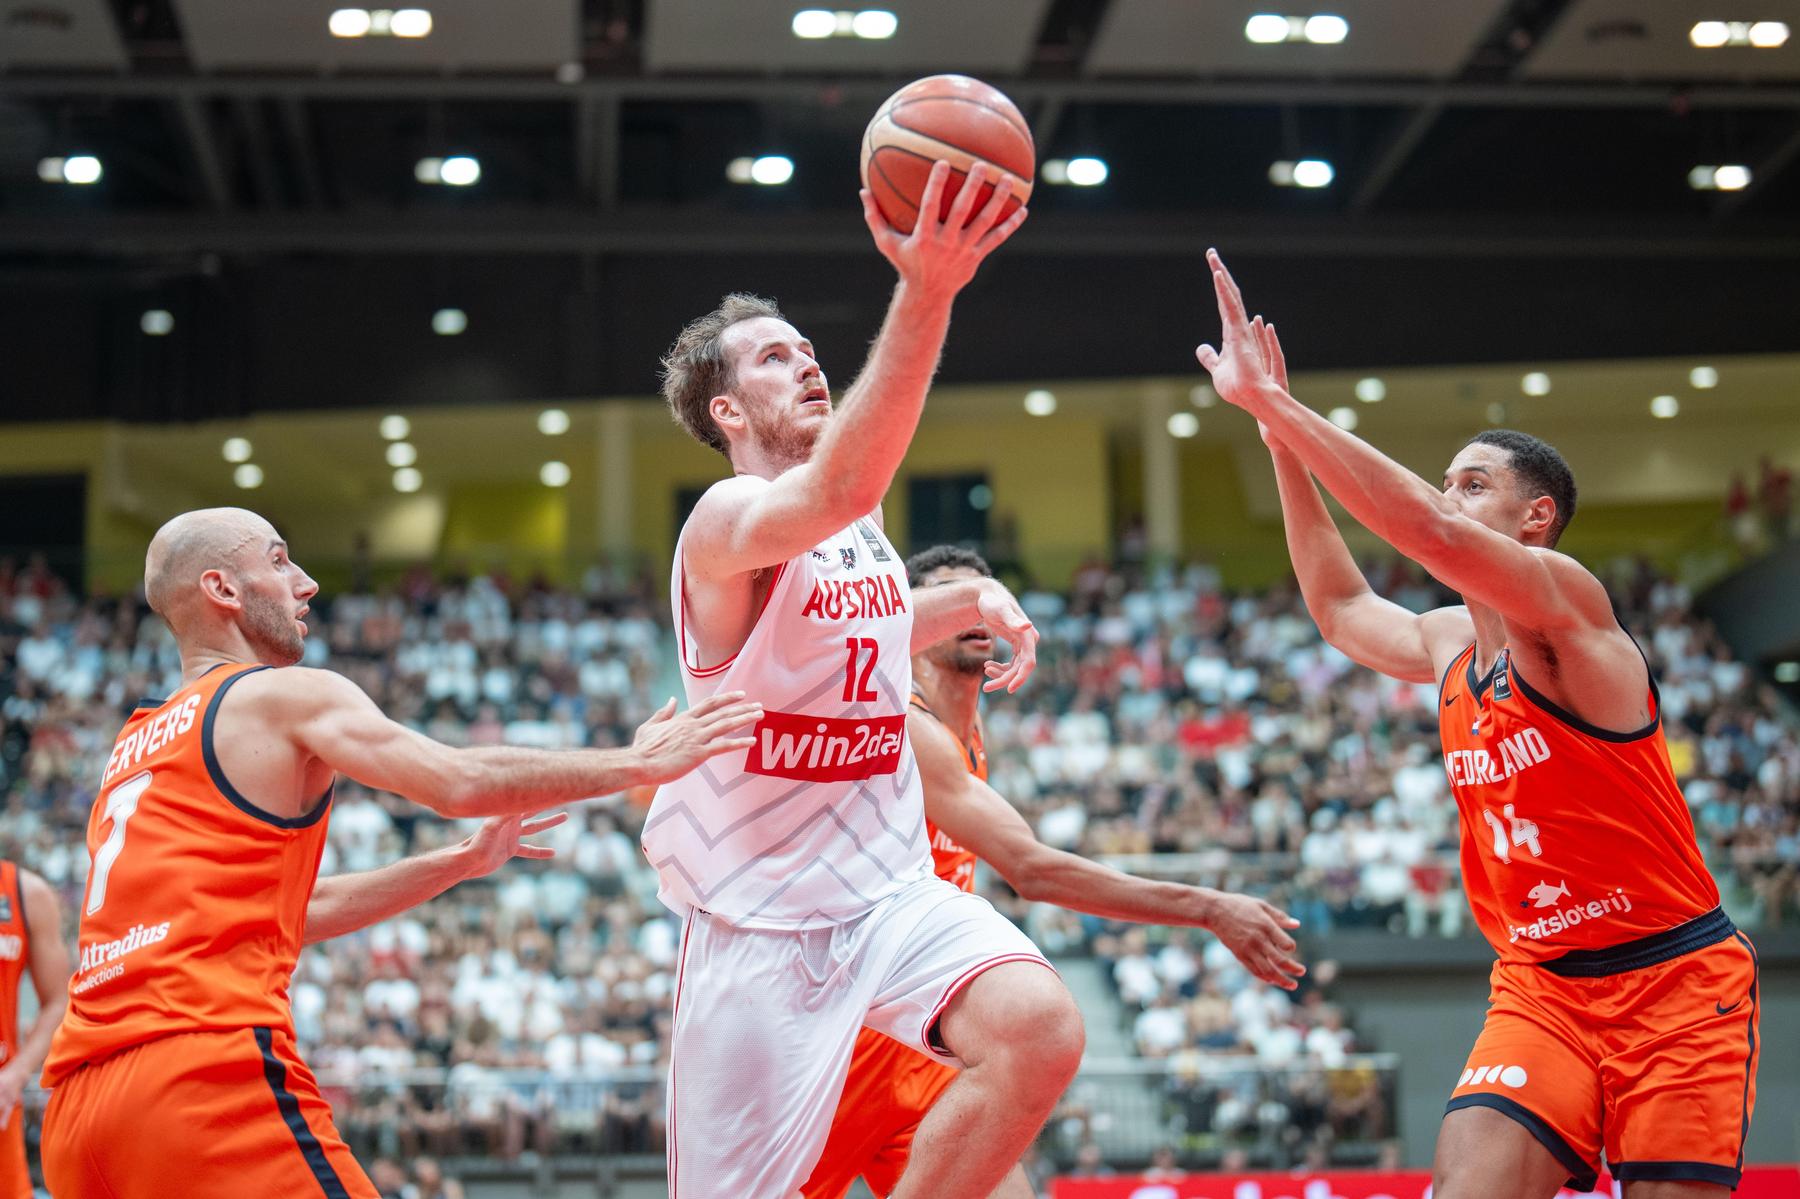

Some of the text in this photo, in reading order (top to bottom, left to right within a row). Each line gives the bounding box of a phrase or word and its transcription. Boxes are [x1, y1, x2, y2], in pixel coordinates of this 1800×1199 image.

[801, 574, 906, 620] AUSTRIA
[842, 637, 879, 702] 12
[100, 694, 201, 791] ERVERS
[86, 769, 153, 917] 7
[1482, 803, 1543, 864] 14
[80, 921, 170, 975] Atradius
